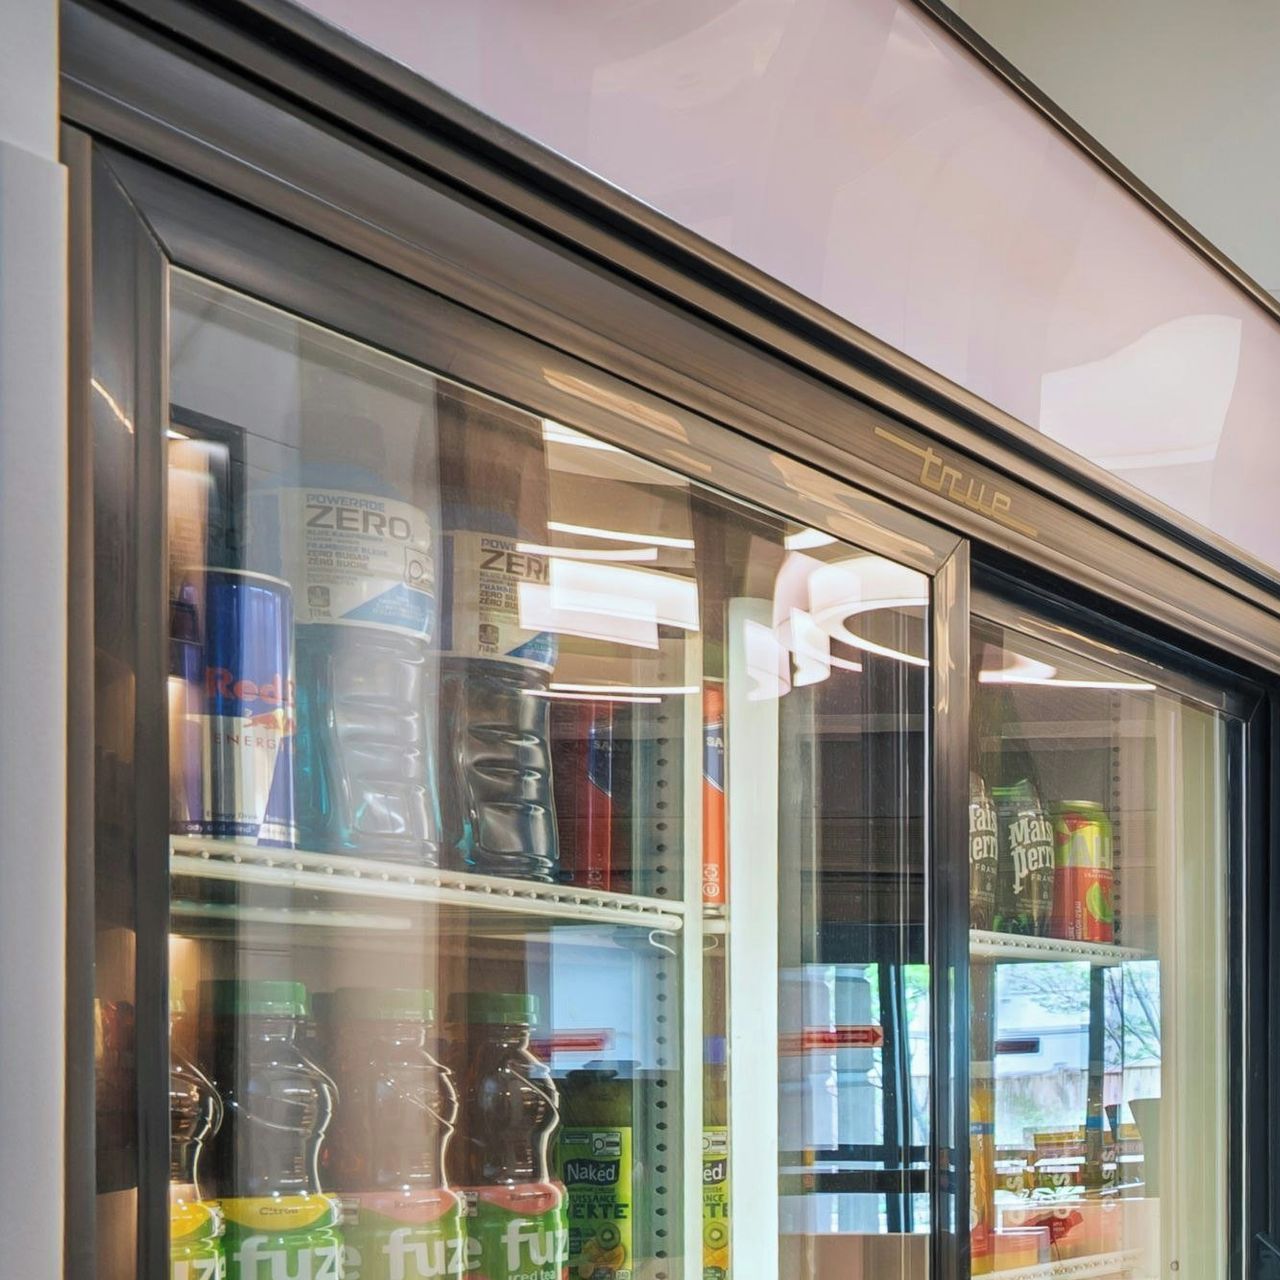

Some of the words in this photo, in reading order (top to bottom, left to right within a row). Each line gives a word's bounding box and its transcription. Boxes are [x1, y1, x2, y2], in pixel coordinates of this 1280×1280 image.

[305, 504, 412, 541] ZERO
[203, 666, 283, 705] Red
[566, 1162, 617, 1182] Naked
